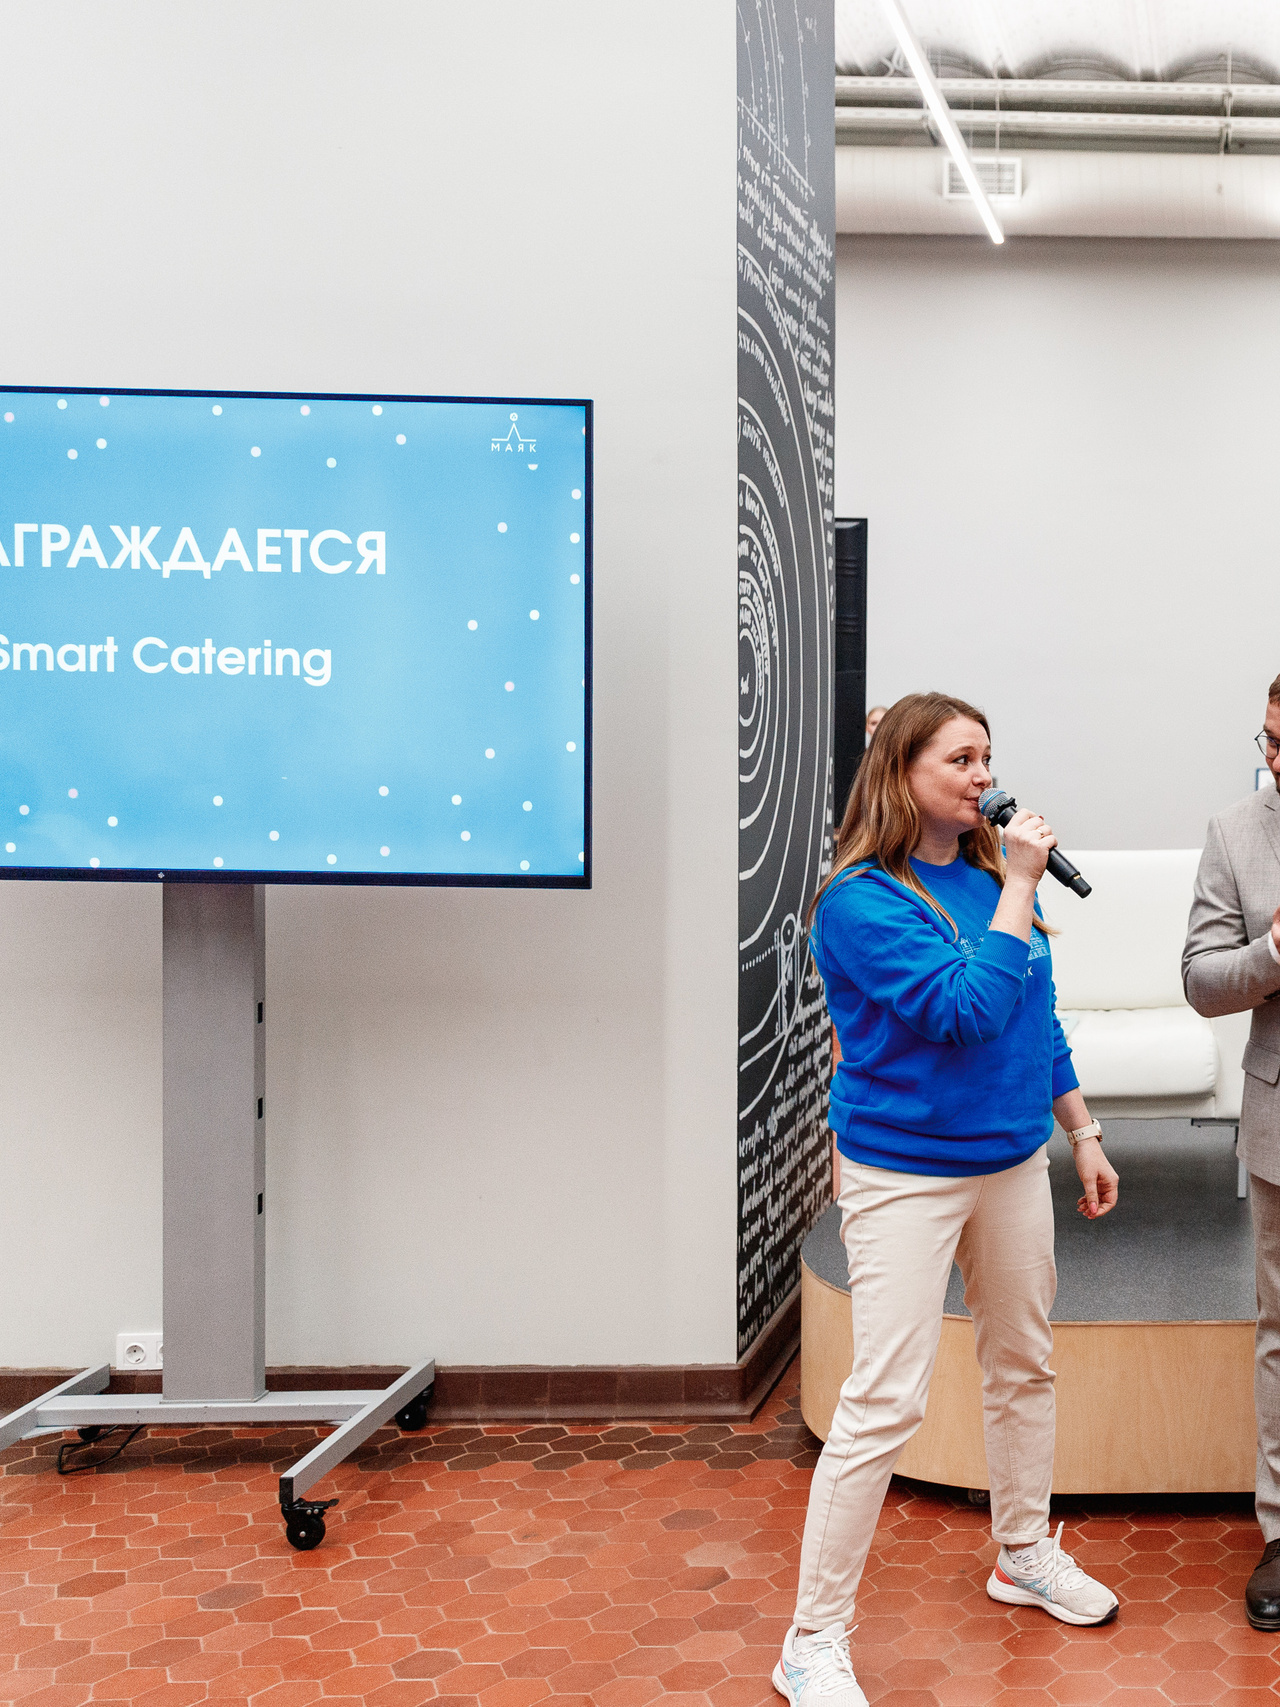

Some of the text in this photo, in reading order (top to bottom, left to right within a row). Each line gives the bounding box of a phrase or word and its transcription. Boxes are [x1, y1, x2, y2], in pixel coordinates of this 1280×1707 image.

[491, 443, 537, 453] МАЯК
[0, 523, 387, 580] ГРАЖДАЕТСЯ
[132, 636, 332, 687] Catering
